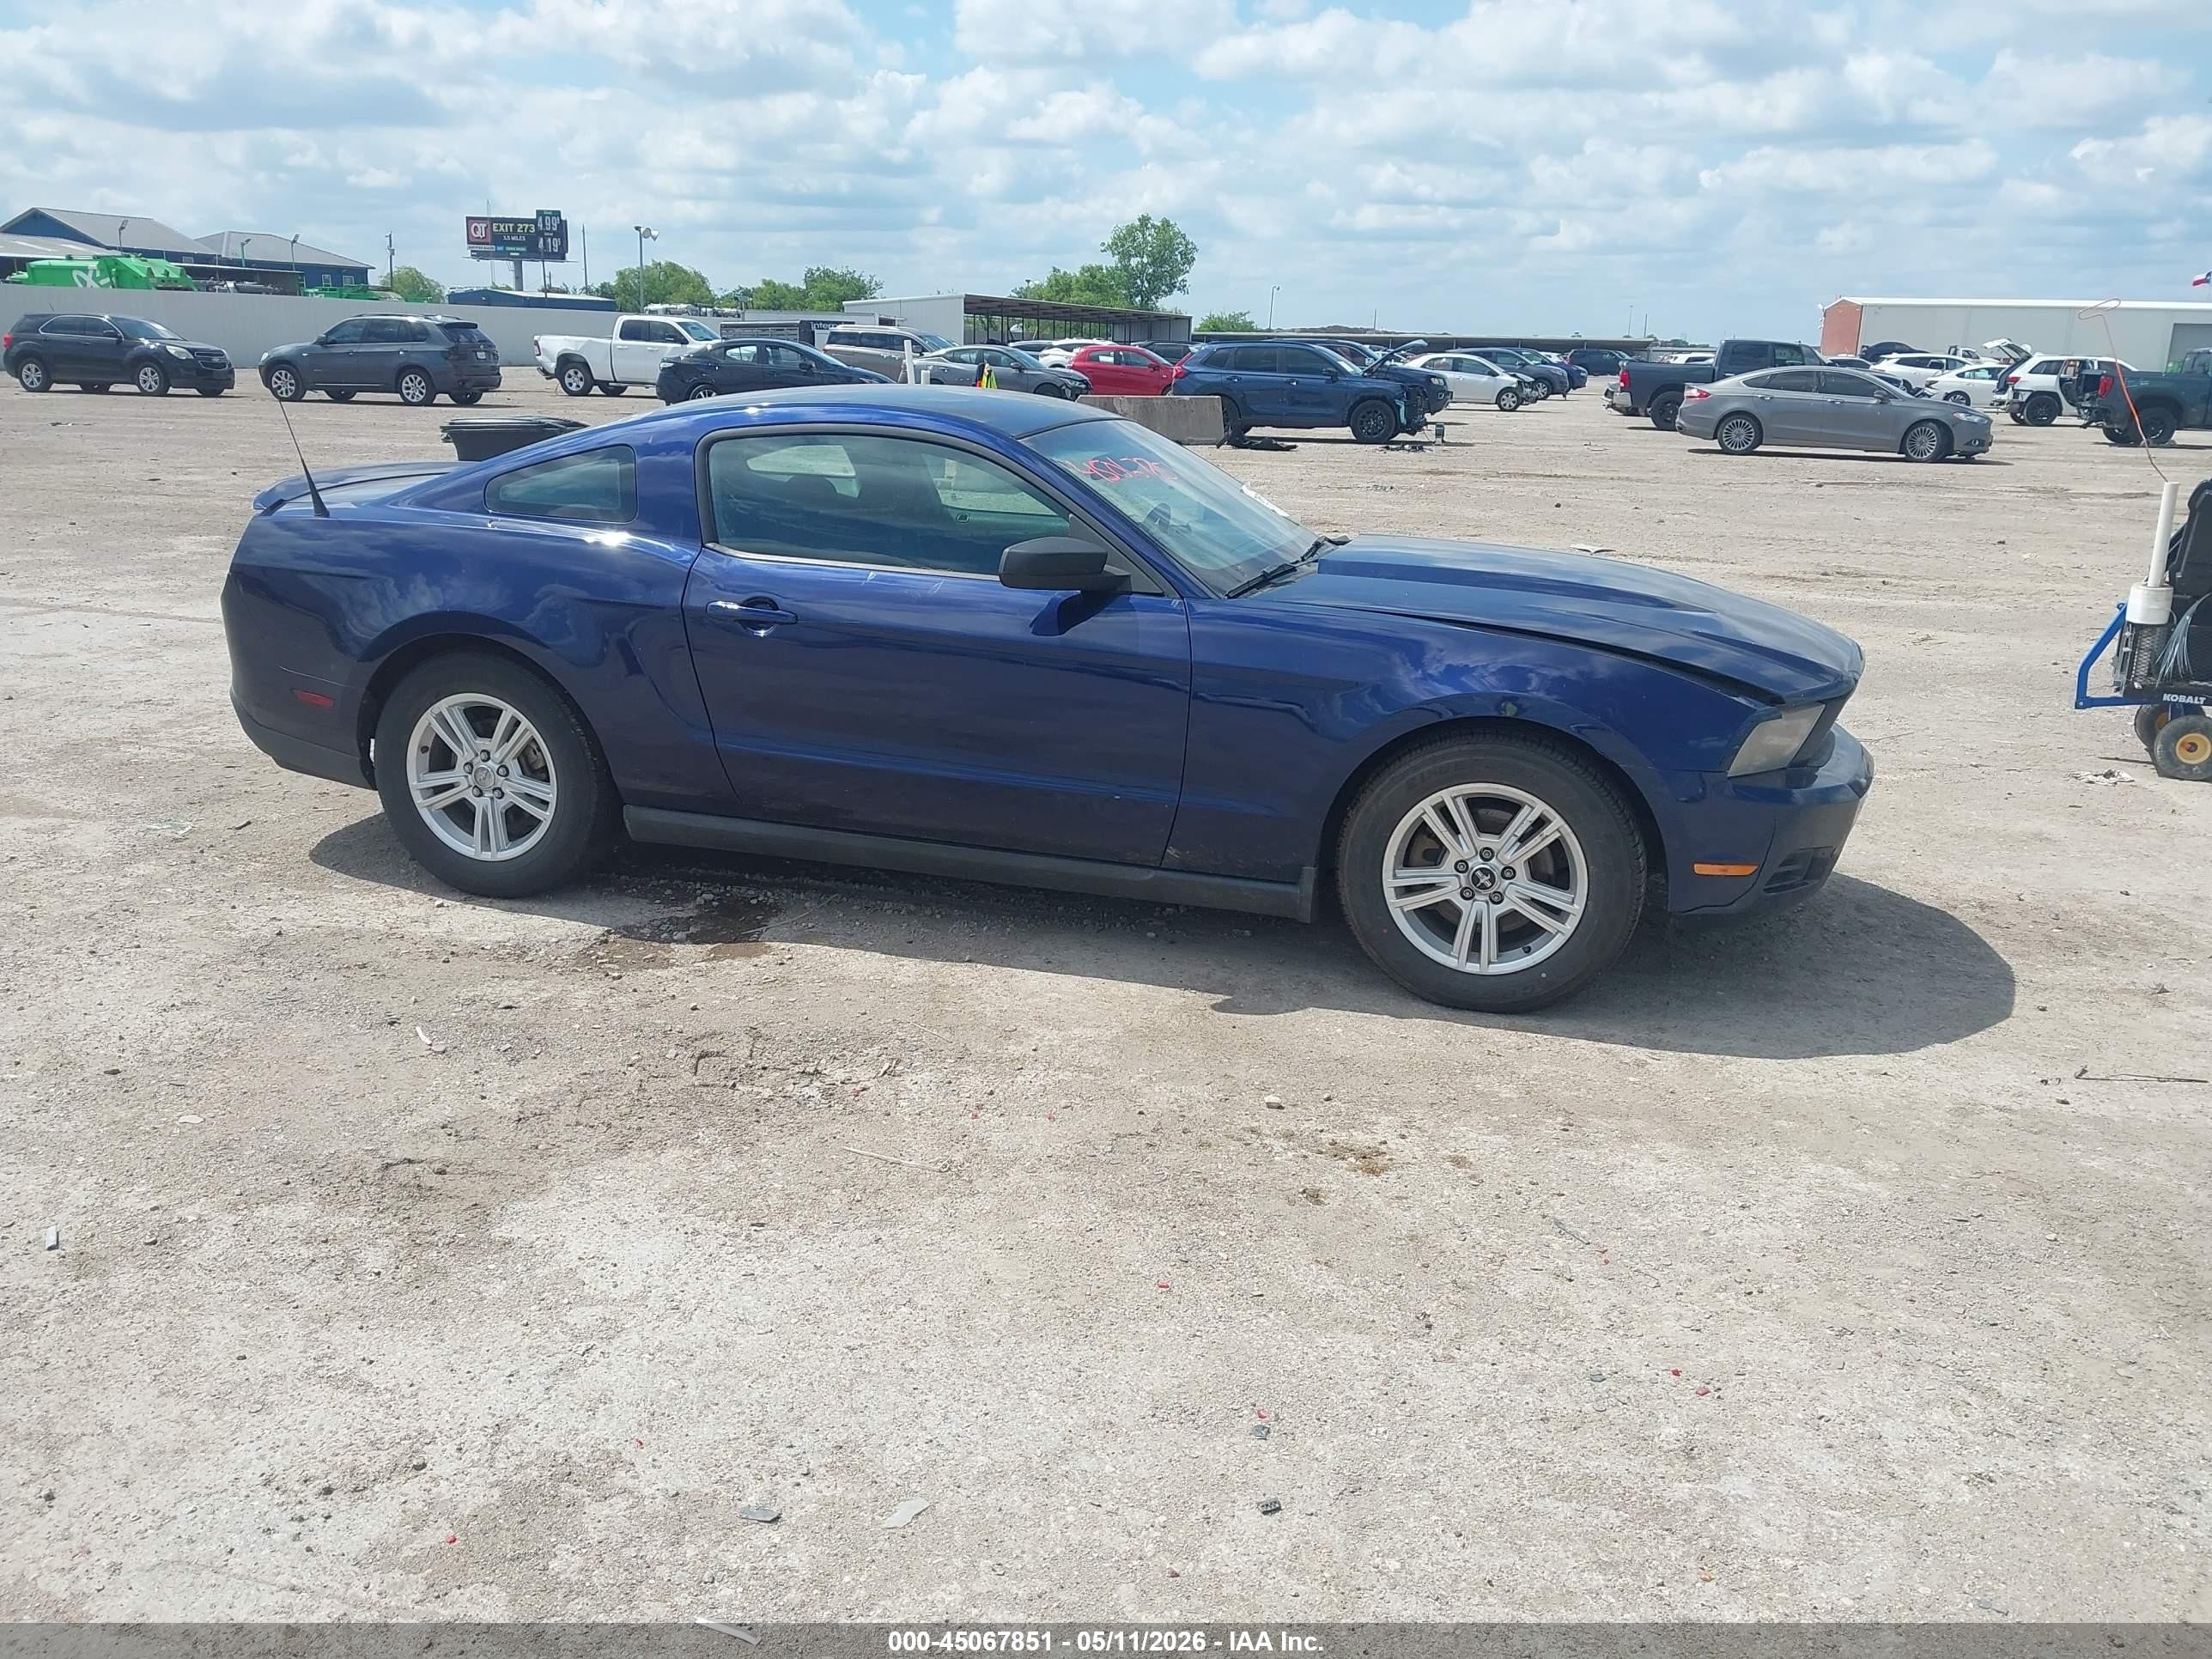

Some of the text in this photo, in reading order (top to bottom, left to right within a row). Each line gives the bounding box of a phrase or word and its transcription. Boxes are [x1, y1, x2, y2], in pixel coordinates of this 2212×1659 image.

[471, 222, 487, 239] QT
[493, 222, 536, 233] EXIT 273
[2162, 693, 2207, 705] KOBALT
